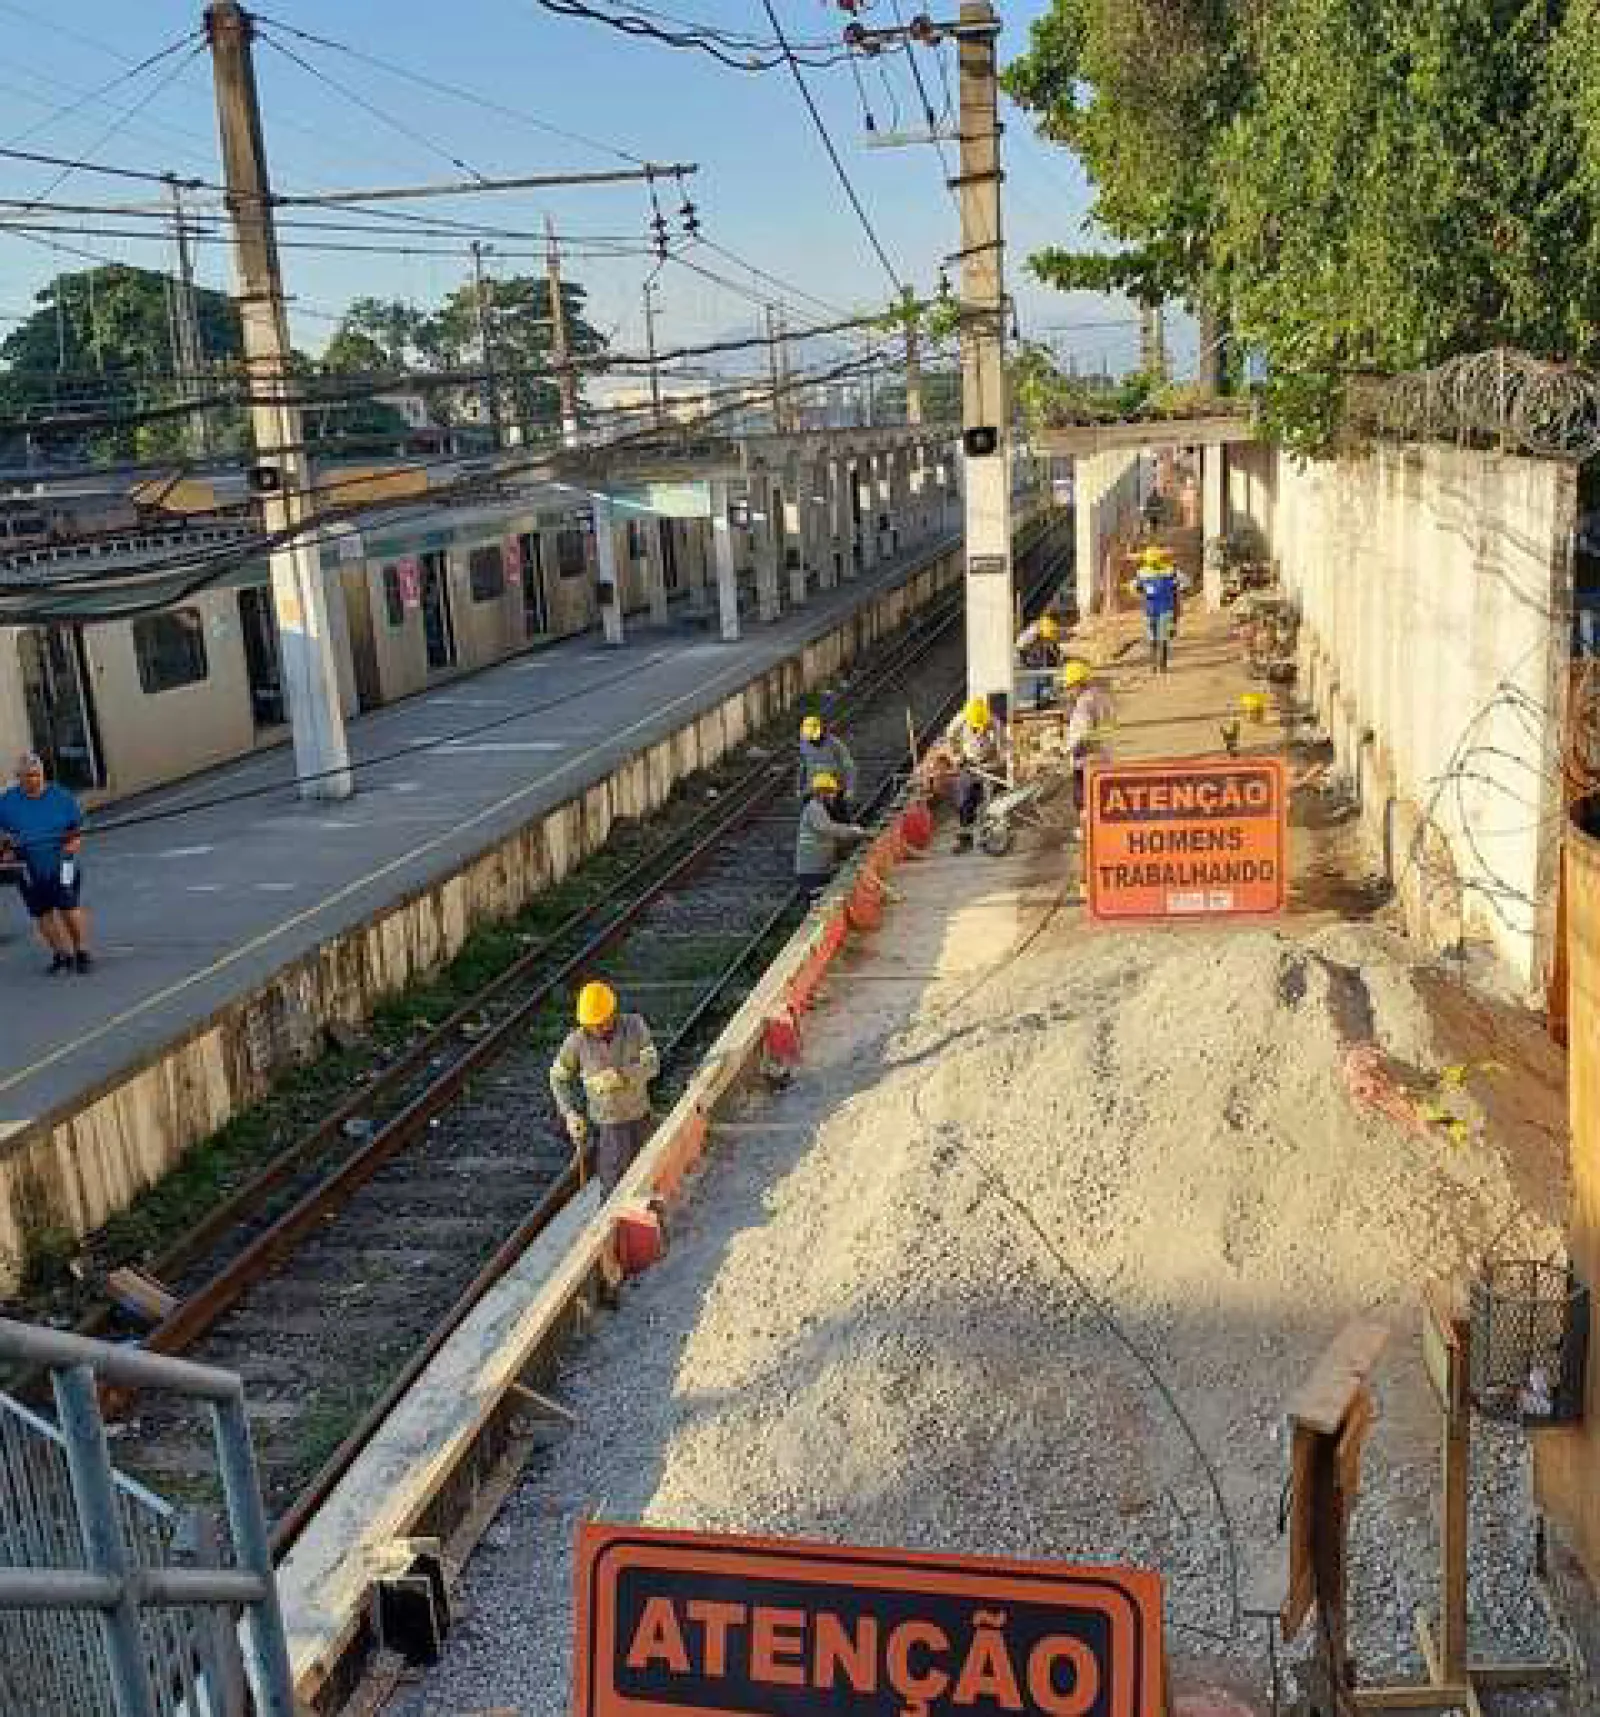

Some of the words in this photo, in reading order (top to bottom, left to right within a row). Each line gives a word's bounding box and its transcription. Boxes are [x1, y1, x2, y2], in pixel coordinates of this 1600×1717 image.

[1102, 777, 1268, 814] ATENÇÃO
[1126, 826, 1244, 854] HOMENS
[1099, 859, 1275, 888] TRABALHANDO
[625, 1595, 1099, 1717] ATENÇÃO
